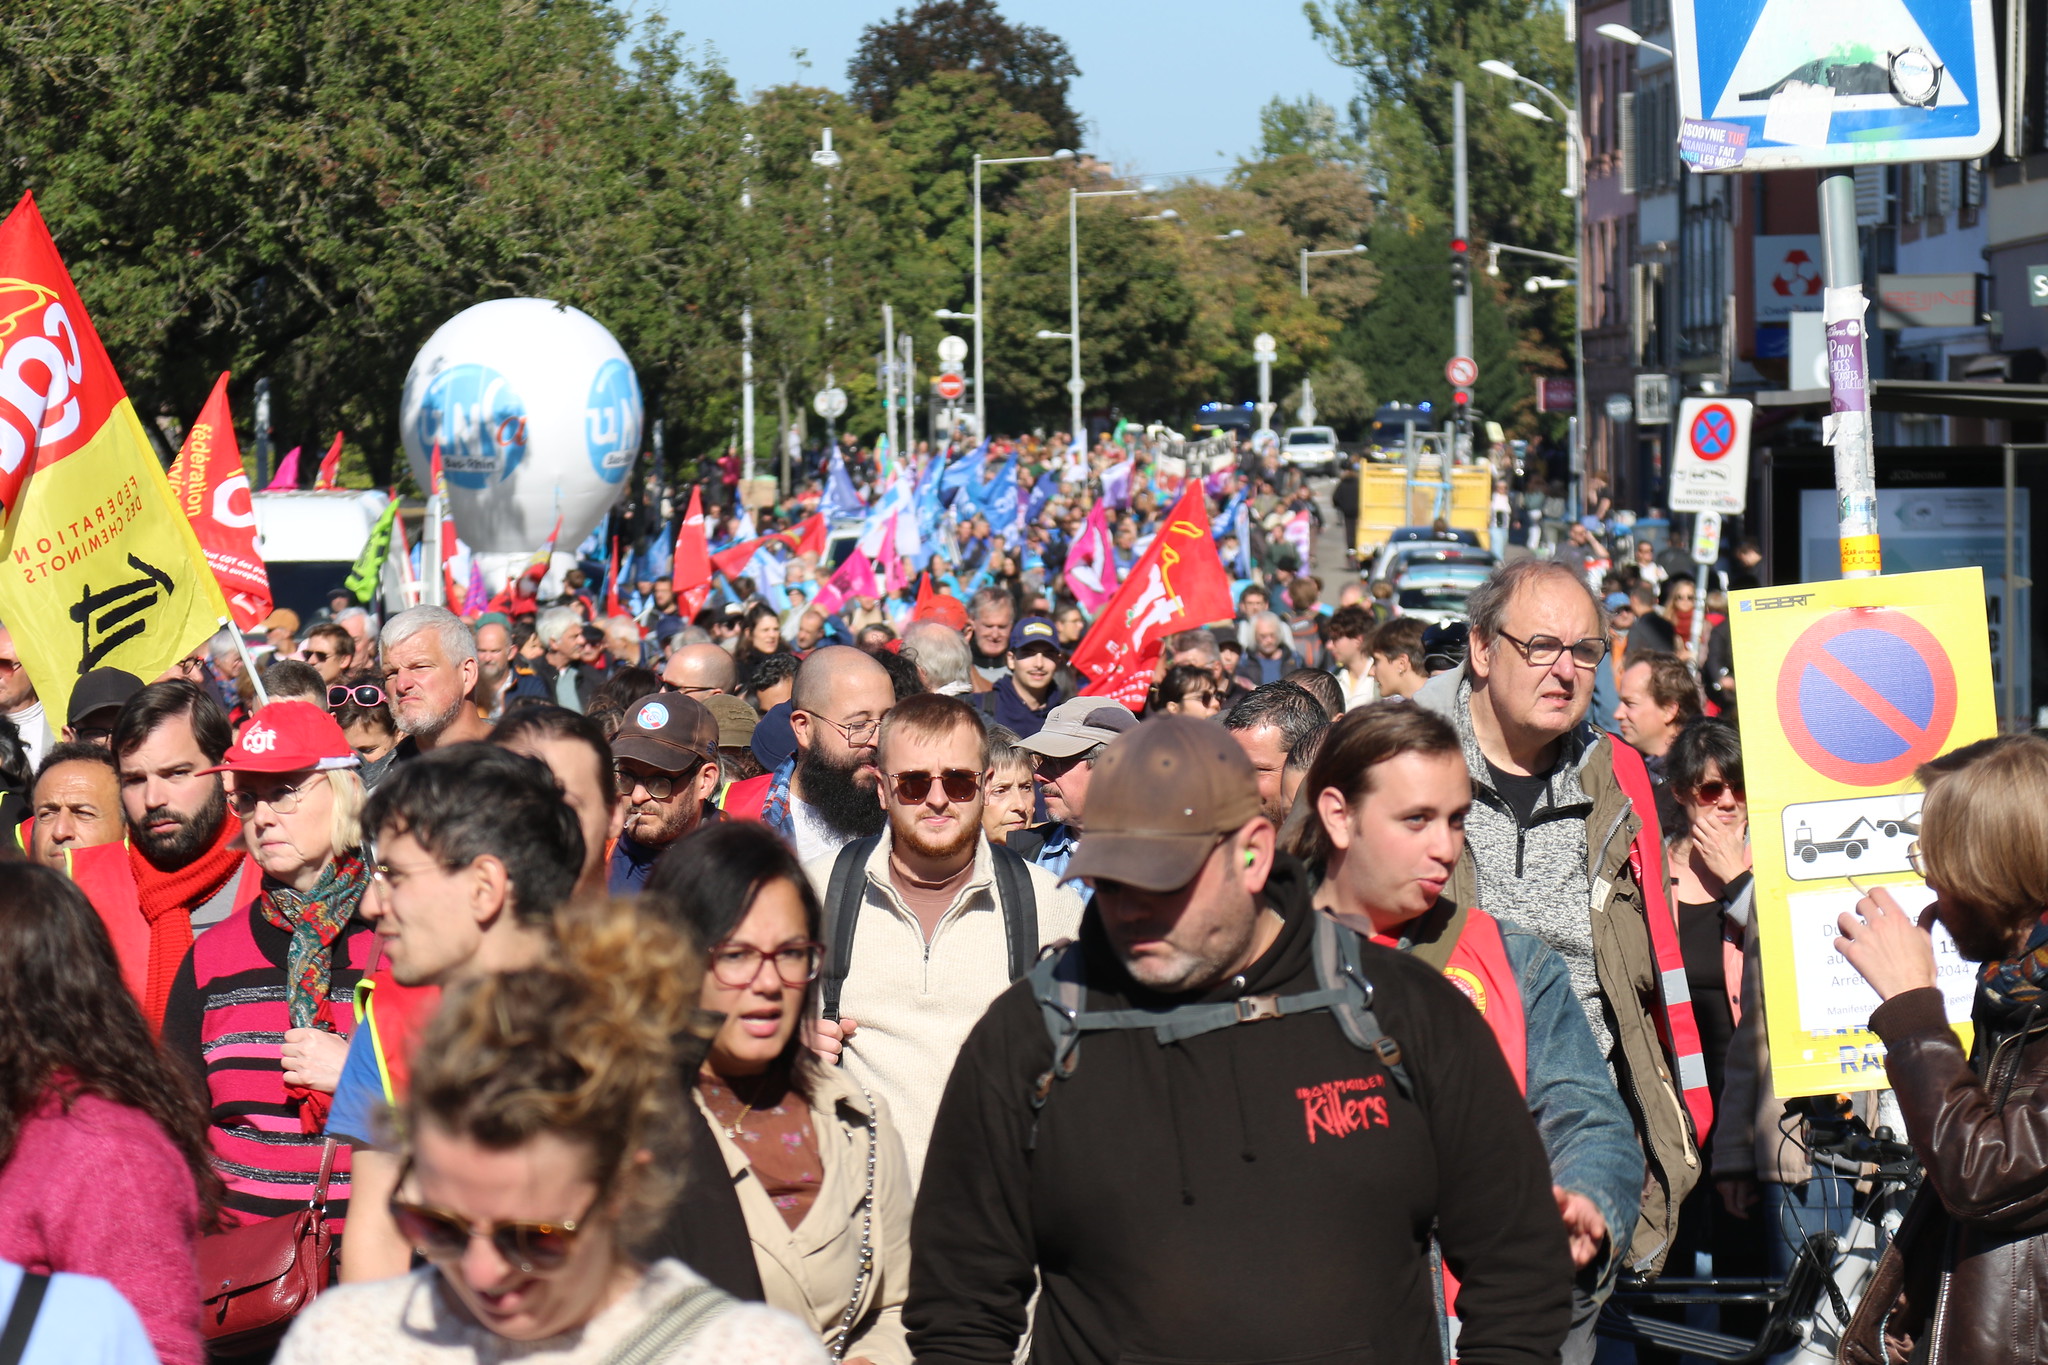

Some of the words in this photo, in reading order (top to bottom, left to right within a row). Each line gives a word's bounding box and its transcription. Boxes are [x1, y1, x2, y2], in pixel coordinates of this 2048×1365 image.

[1727, 131, 1746, 146] TUE
[1700, 153, 1714, 166] LES
[1719, 145, 1736, 158] FAIT
[187, 423, 212, 517] fédération
[242, 729, 277, 754] cgt
[1304, 1088, 1390, 1144] Killers
